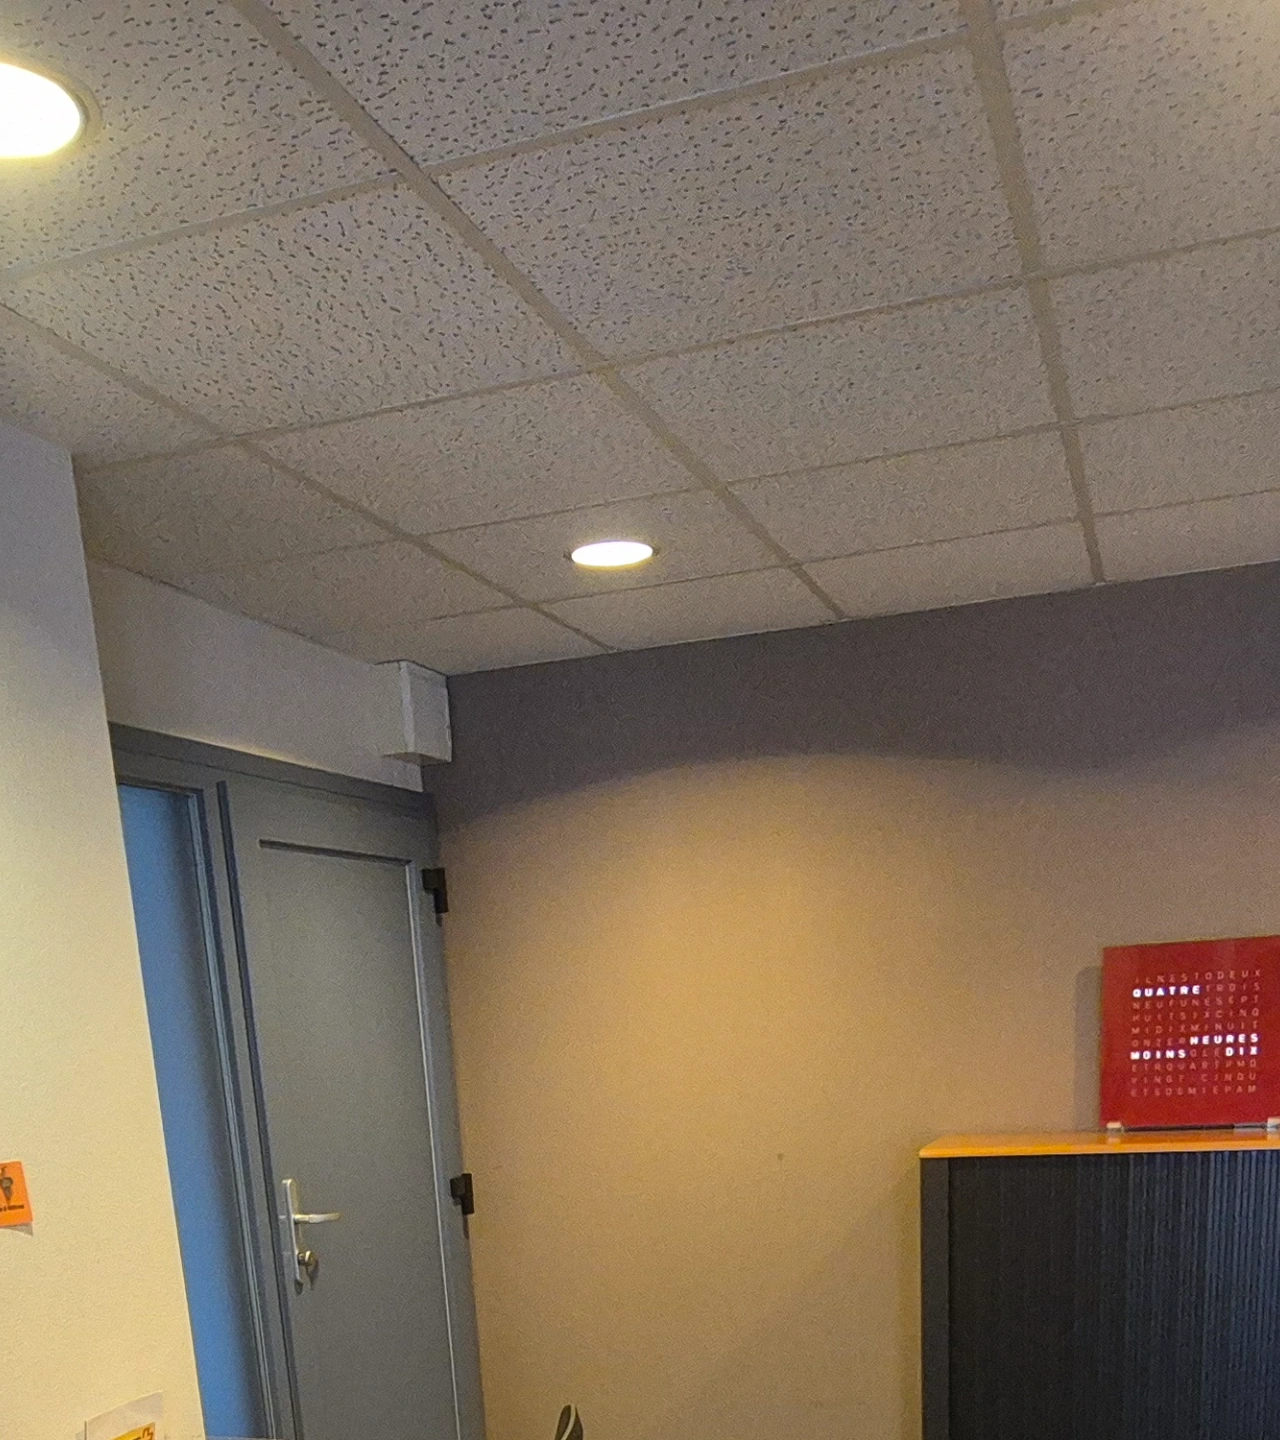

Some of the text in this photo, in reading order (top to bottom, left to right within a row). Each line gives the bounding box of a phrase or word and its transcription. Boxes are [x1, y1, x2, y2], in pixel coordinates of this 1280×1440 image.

[1132, 984, 1201, 998] QUATRE
[1189, 1033, 1259, 1046] HEURES
[1130, 1048, 1187, 1060] MOINS
[1225, 1046, 1258, 1057] DIX
